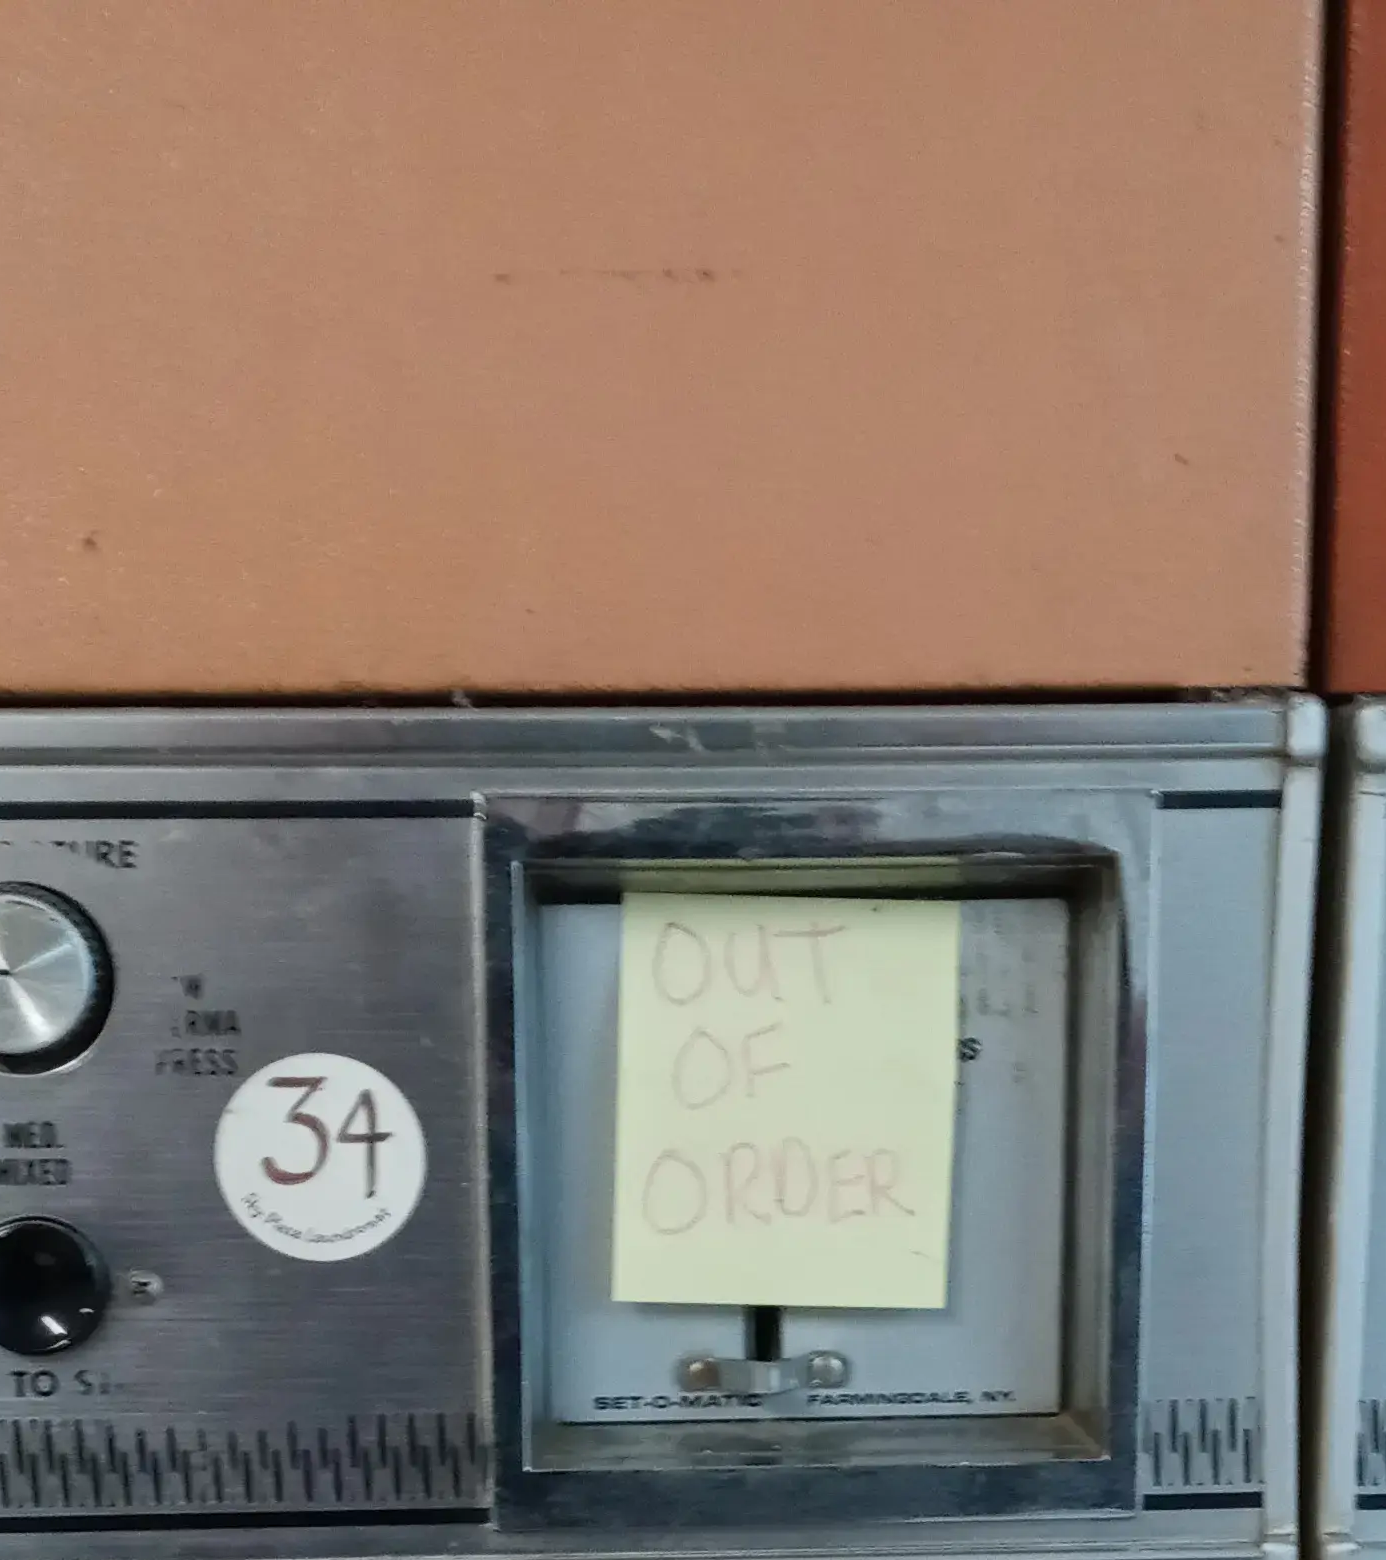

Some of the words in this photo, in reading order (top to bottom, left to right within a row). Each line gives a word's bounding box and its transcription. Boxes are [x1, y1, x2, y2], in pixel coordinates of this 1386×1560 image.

[651, 921, 845, 1005] OUT
[672, 1021, 791, 1110] OF
[259, 1076, 393, 1199] 34
[642, 1136, 916, 1236] ORDER
[9, 1369, 60, 1398] TO
